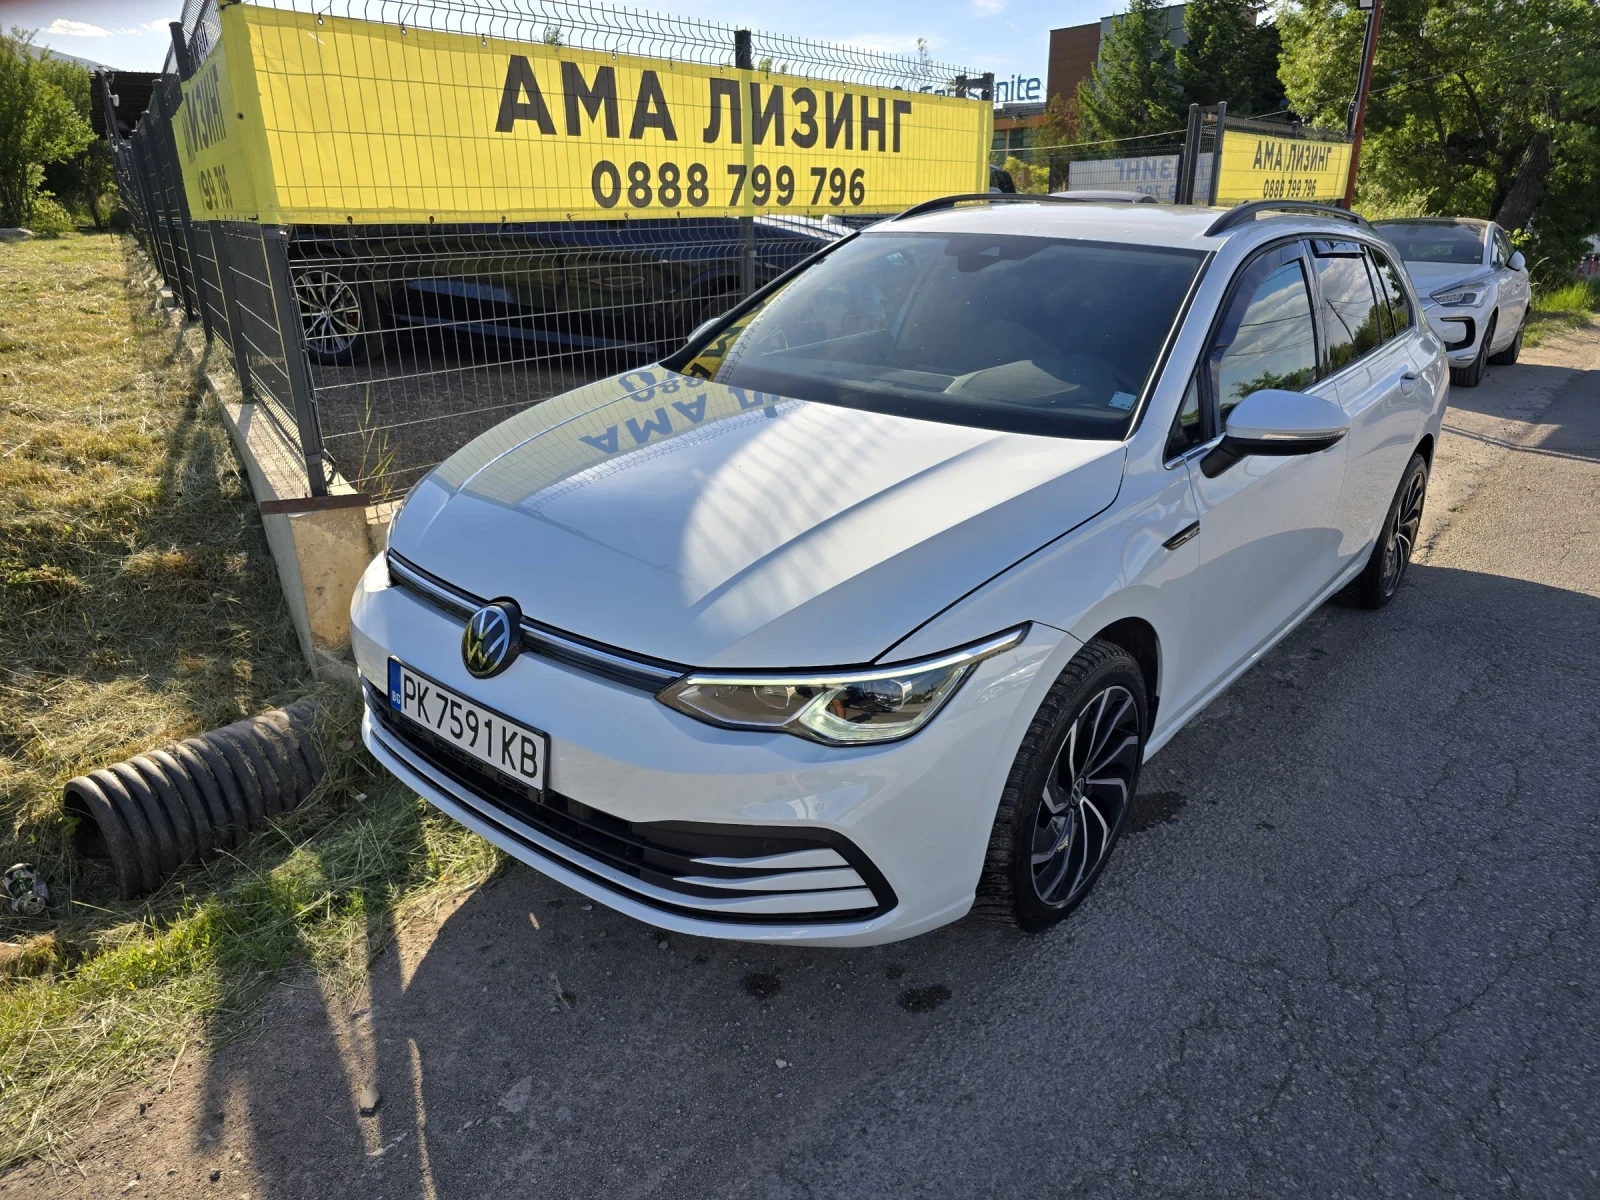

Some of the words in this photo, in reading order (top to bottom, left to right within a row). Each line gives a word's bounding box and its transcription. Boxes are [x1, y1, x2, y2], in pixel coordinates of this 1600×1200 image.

[495, 55, 678, 141] АМА
[703, 77, 911, 153] ЛИЗИНГ
[1253, 140, 1282, 171] АМА
[1286, 144, 1332, 172] ЛИЗИНГ
[591, 160, 709, 209] 0888
[727, 165, 795, 207] 799
[810, 167, 865, 206] 796
[1263, 178, 1285, 199] 0888
[1286, 179, 1301, 198] 799
[1302, 179, 1317, 198] 796
[391, 690, 401, 705] BG
